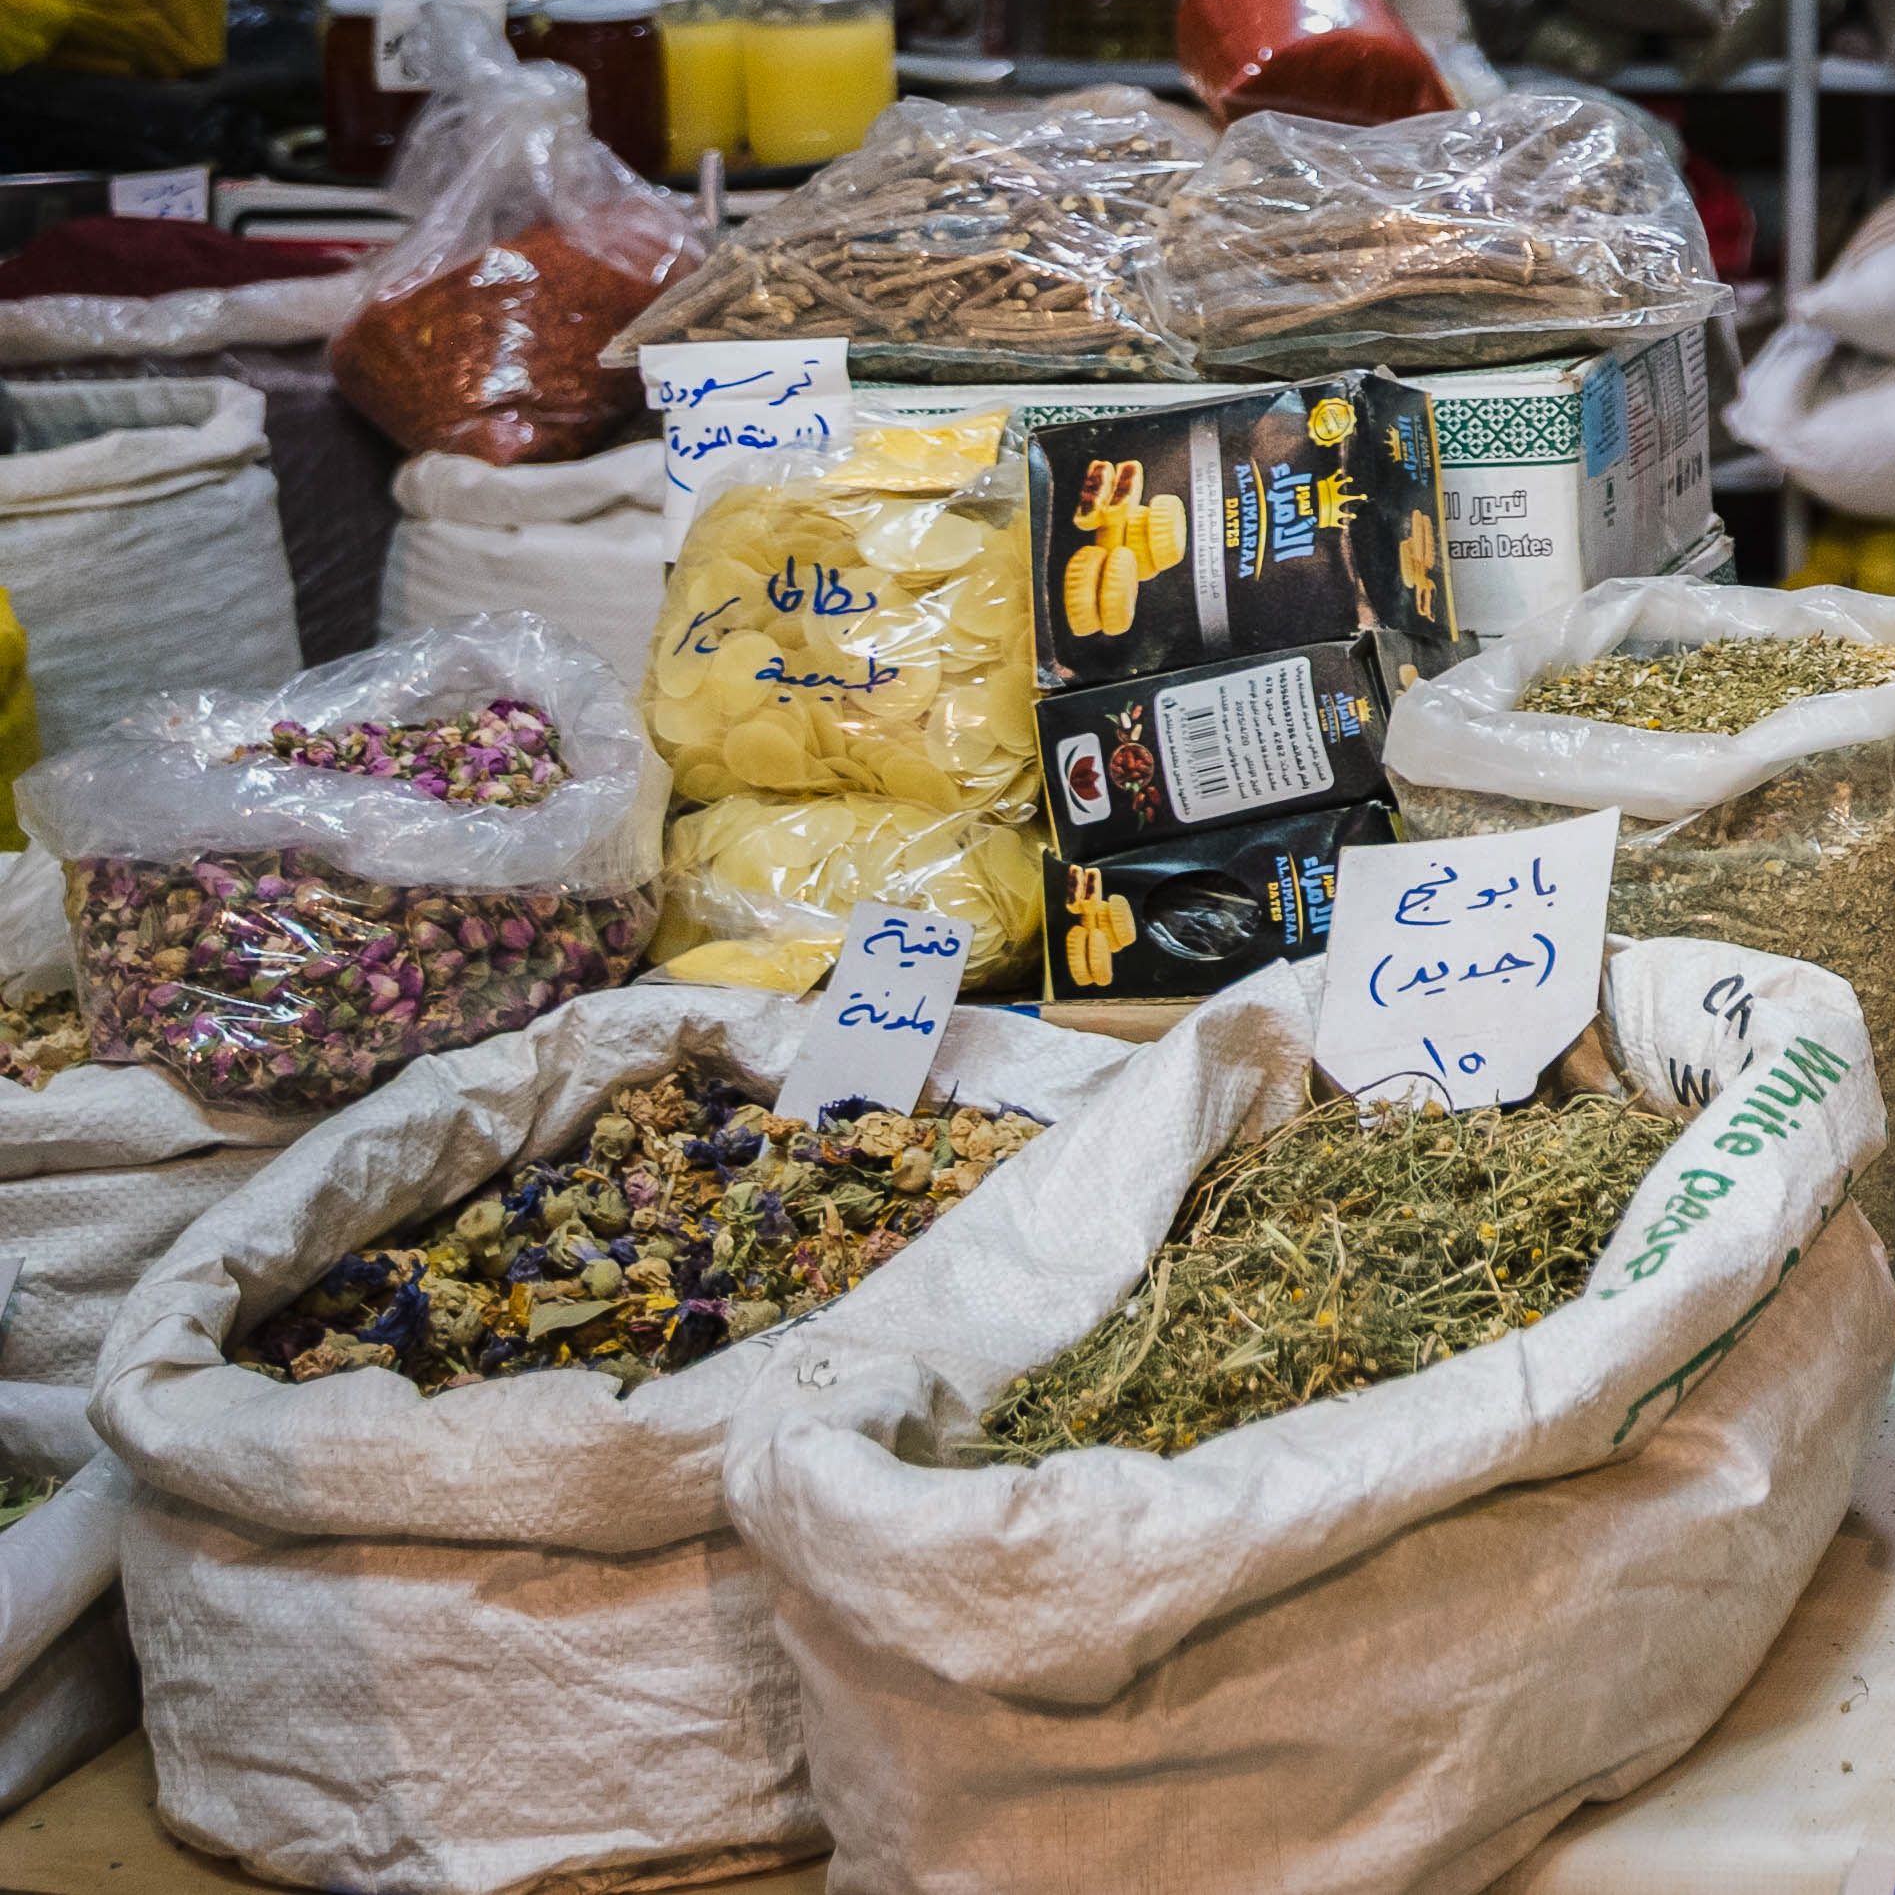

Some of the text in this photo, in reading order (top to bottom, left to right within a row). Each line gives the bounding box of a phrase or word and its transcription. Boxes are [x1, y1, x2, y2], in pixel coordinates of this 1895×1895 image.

[660, 360, 820, 412] تمر سعودي
[1225, 497, 1240, 548] DATES
[1234, 464, 1258, 578] AL.UMARAA
[1266, 463, 1317, 562] الأمراء
[1470, 491, 1527, 525] تمور
[1448, 534, 1553, 559] arah Dates
[1273, 732, 1286, 757] 4282
[1268, 882, 1282, 922] DATES
[1275, 857, 1297, 945] AL.UMARAA
[1394, 857, 1558, 927] بابونج
[1369, 933, 1556, 1008] (جديد)
[838, 991, 936, 1035] ملونة
[1713, 1036, 1850, 1156] White
